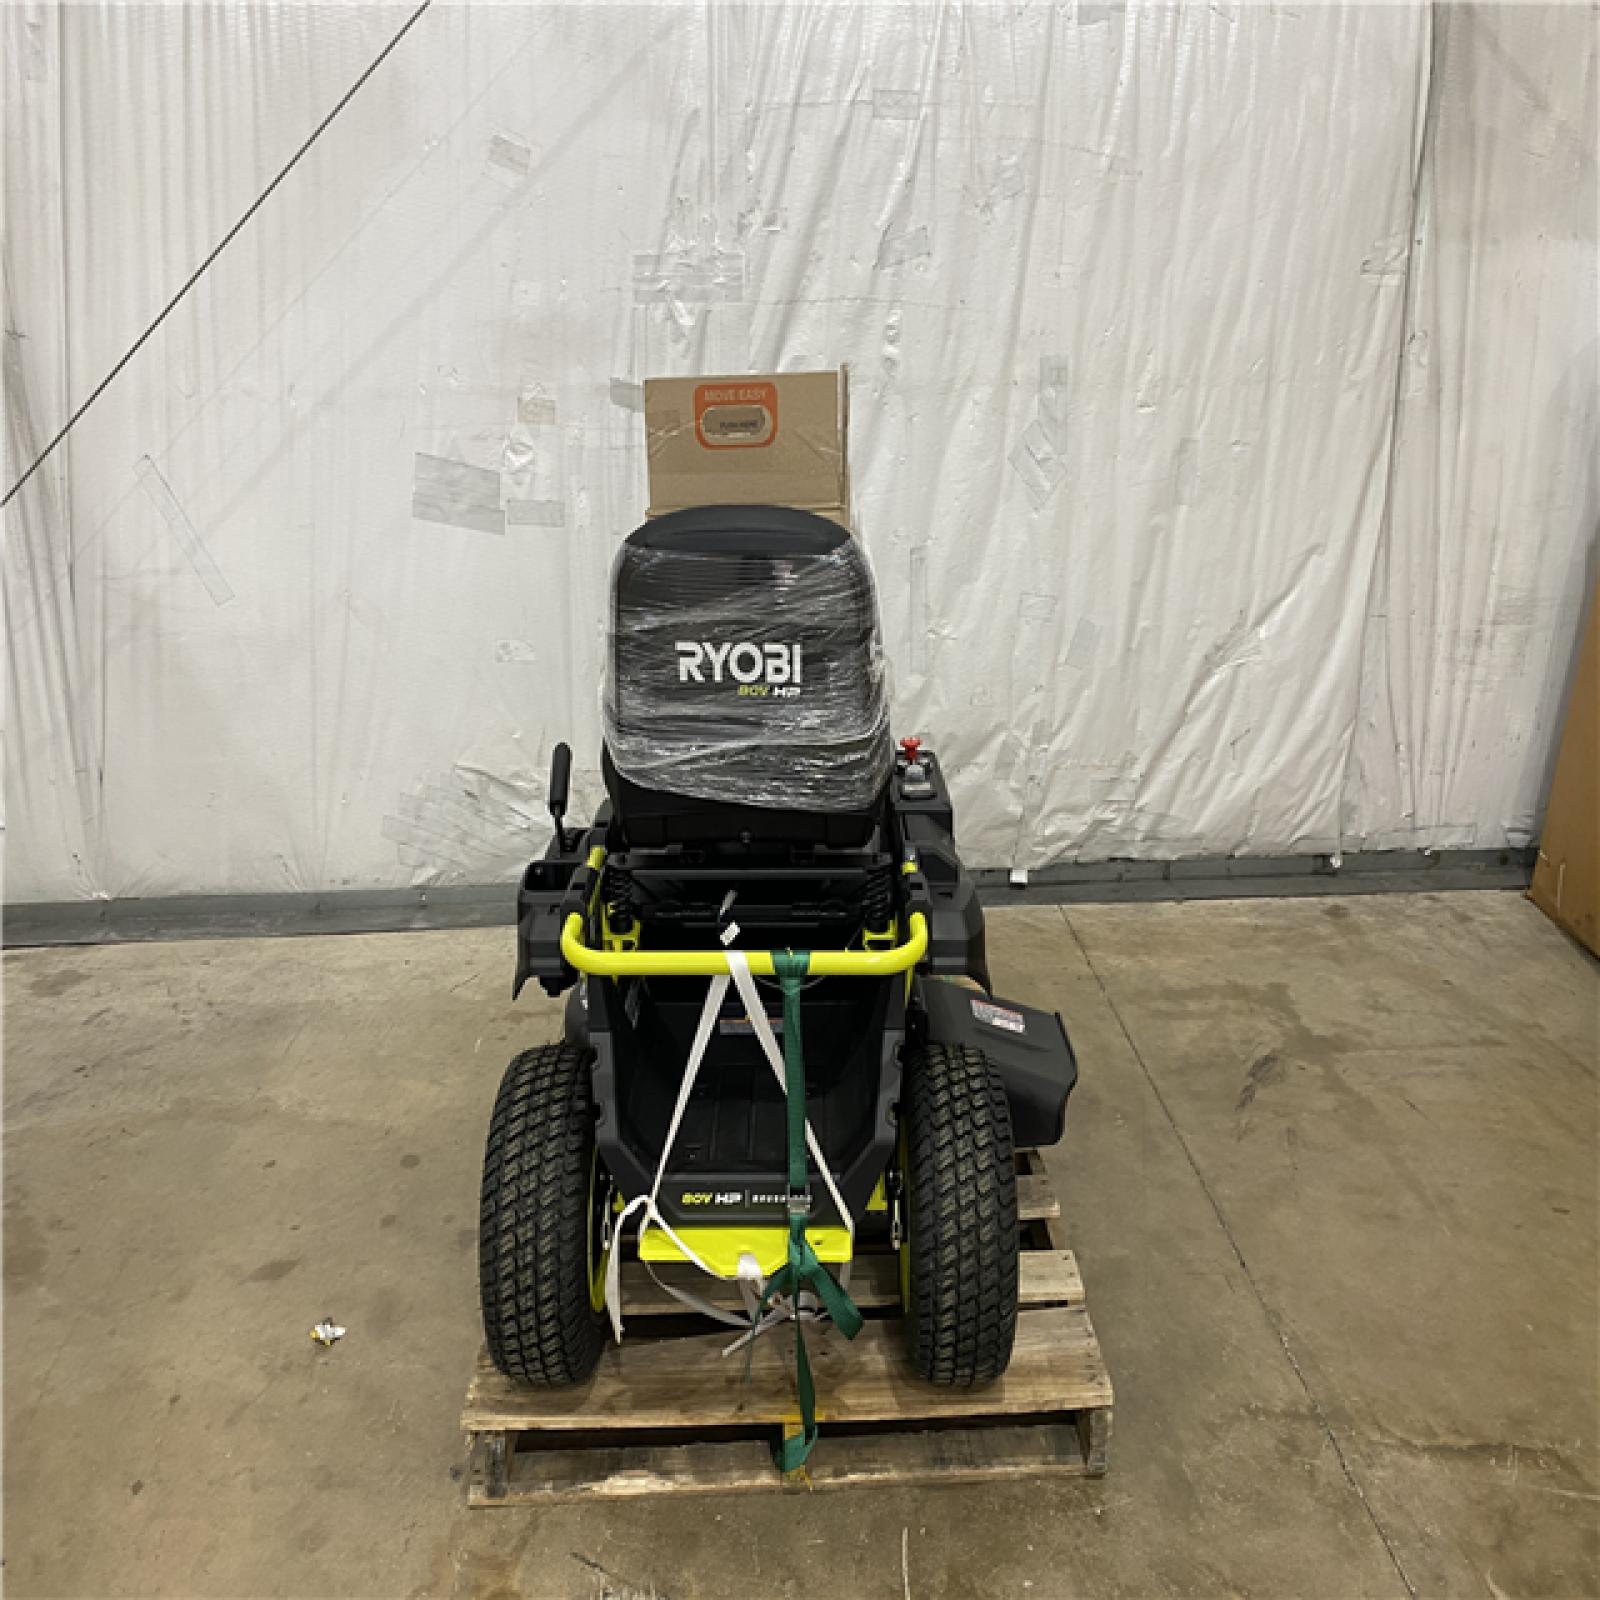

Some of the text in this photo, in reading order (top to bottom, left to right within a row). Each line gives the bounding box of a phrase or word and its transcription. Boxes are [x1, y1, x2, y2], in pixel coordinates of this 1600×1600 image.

[704, 387, 767, 401] MOVE EASY
[675, 641, 803, 683] RYOBI
[714, 1192, 743, 1205] HP
